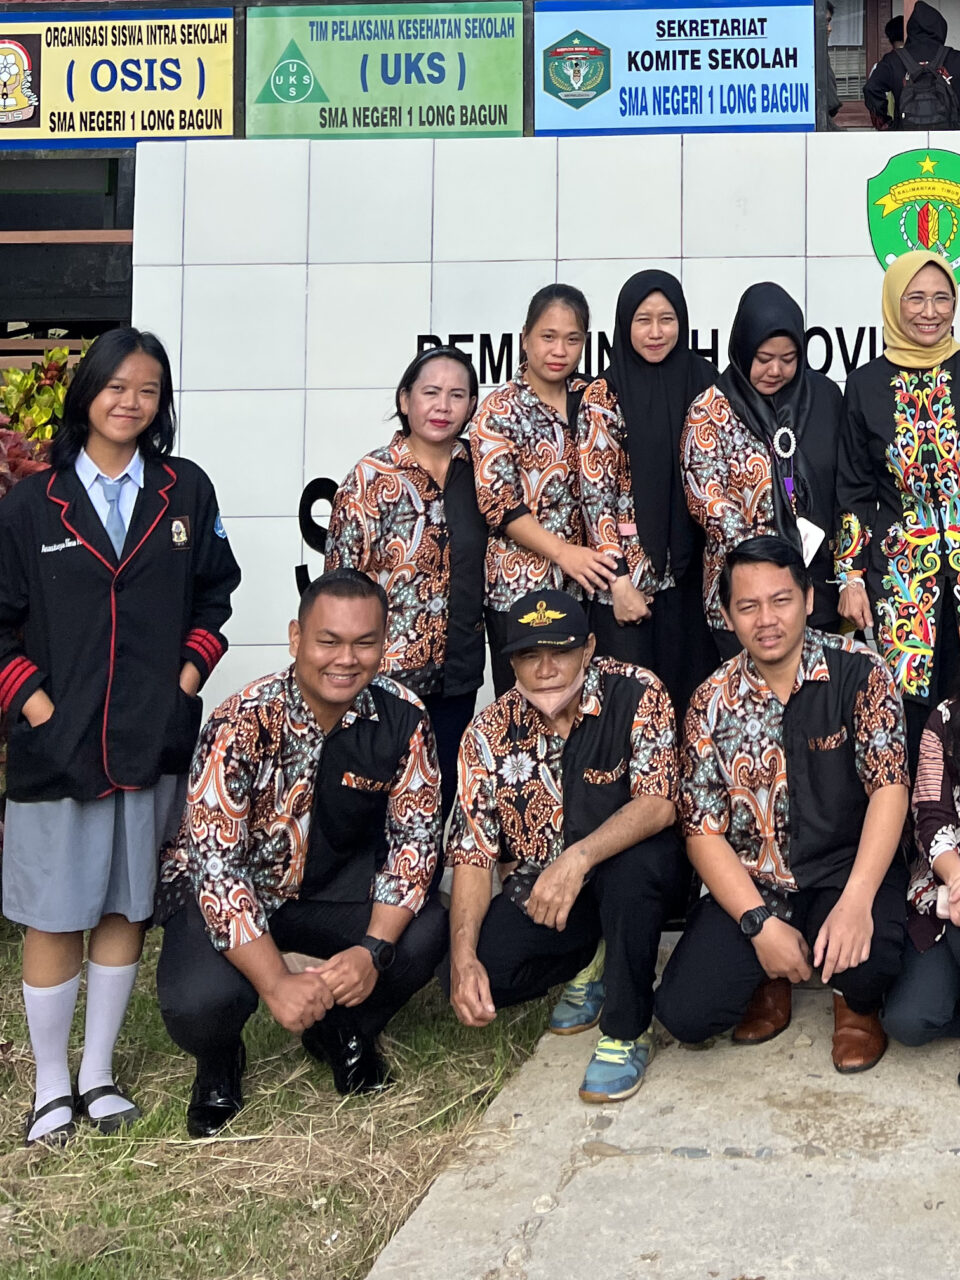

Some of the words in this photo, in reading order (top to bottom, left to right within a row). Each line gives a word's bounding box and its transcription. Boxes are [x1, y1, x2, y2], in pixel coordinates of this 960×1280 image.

[45, 26, 108, 48] ORGANISASI
[111, 25, 143, 46] SISWA
[146, 24, 177, 46] INTRA
[180, 23, 228, 45] SEKOLAH
[309, 20, 328, 41] TIM
[332, 19, 395, 41] PELAKSANA
[398, 18, 461, 40] KESEHATAN
[465, 17, 515, 39] SEKOLAH
[656, 18, 767, 38] SEKRETARIAT
[627, 49, 702, 72] KOMITE
[708, 47, 798, 70] SEKOLAH
[619, 86, 649, 117] SMA
[653, 85, 703, 115] NEGERI
[708, 85, 714, 114] 1
[720, 84, 756, 114] LONG
[761, 82, 809, 113] BAGUN
[0, 111, 22, 121] SIS
[49, 111, 75, 132] SMA
[80, 110, 125, 132] NEGERI
[130, 110, 135, 131] 1
[141, 109, 176, 131] LONG
[180, 109, 223, 130] BAGUN
[319, 107, 348, 129] SMA
[352, 106, 402, 128] NEGERI
[407, 106, 412, 127] 1
[418, 105, 455, 127] LONG
[459, 104, 508, 126] BAGUN
[897, 185, 936, 195] KALIMANTAN
